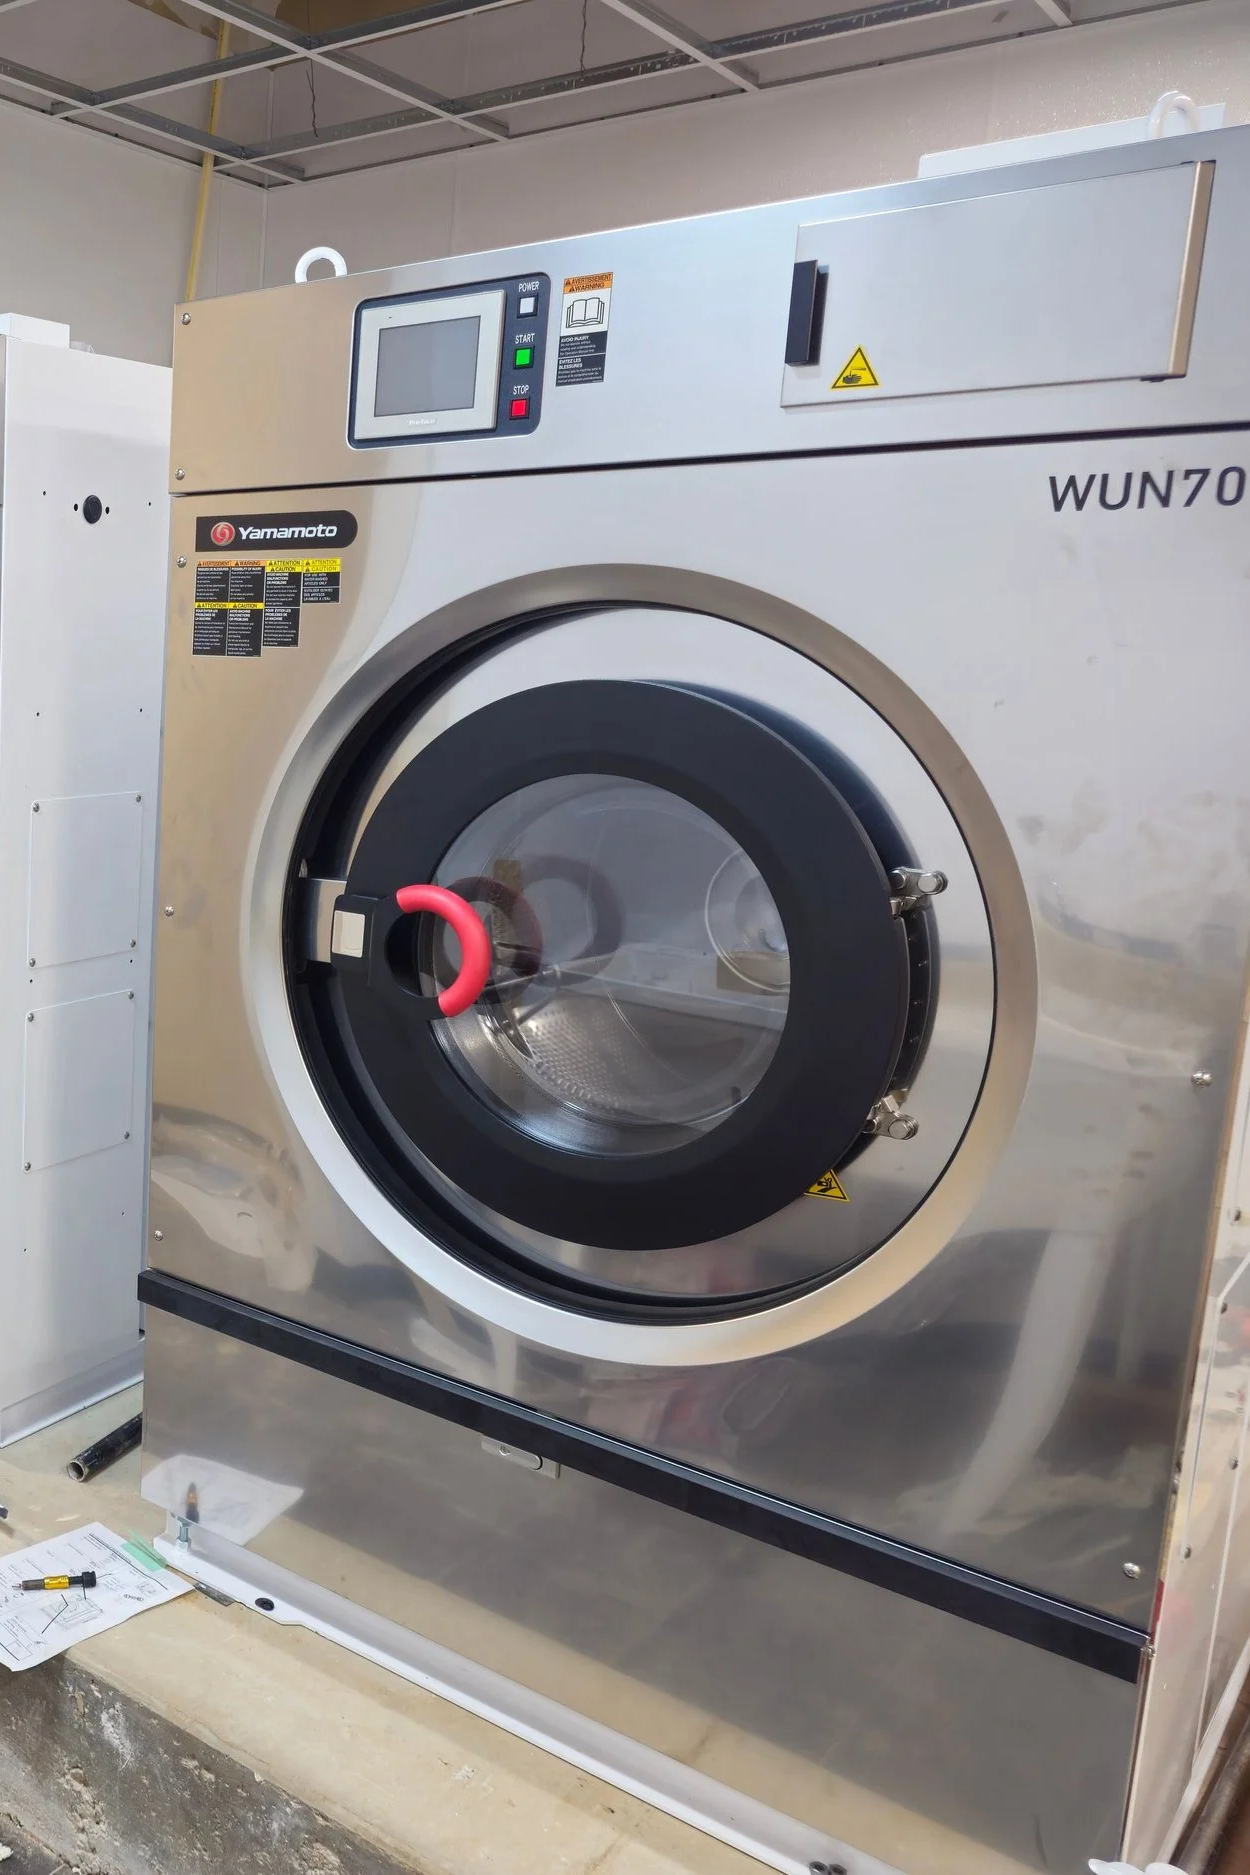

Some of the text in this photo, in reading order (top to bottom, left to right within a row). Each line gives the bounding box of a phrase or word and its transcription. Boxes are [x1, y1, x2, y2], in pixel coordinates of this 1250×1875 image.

[518, 281, 540, 292] POWER
[515, 333, 536, 344] START
[513, 385, 529, 395] STOP
[1049, 466, 1246, 512] WUN70
[238, 524, 338, 540] Yamamoto
